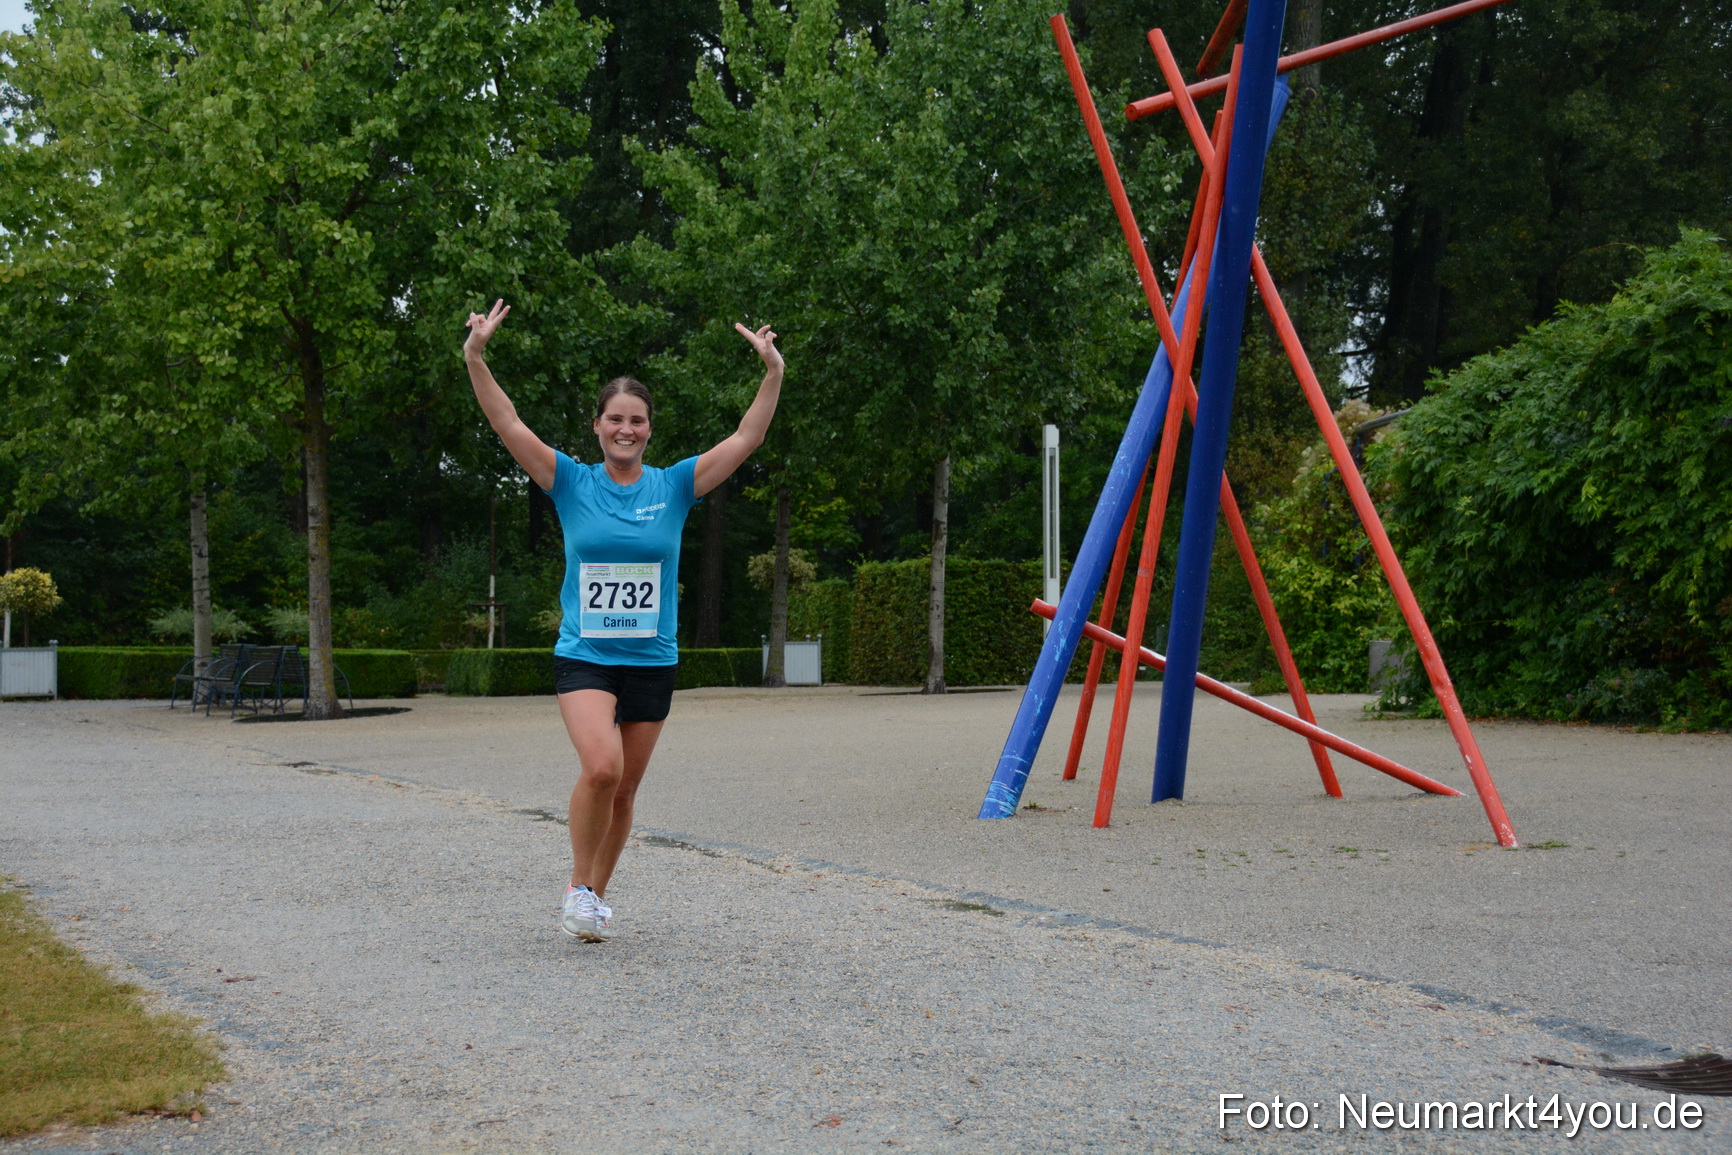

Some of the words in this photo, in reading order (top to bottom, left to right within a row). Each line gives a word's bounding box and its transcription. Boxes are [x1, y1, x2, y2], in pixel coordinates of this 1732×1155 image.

[615, 566, 654, 575] BOCK
[588, 581, 654, 609] 2732
[603, 616, 638, 628] Carina
